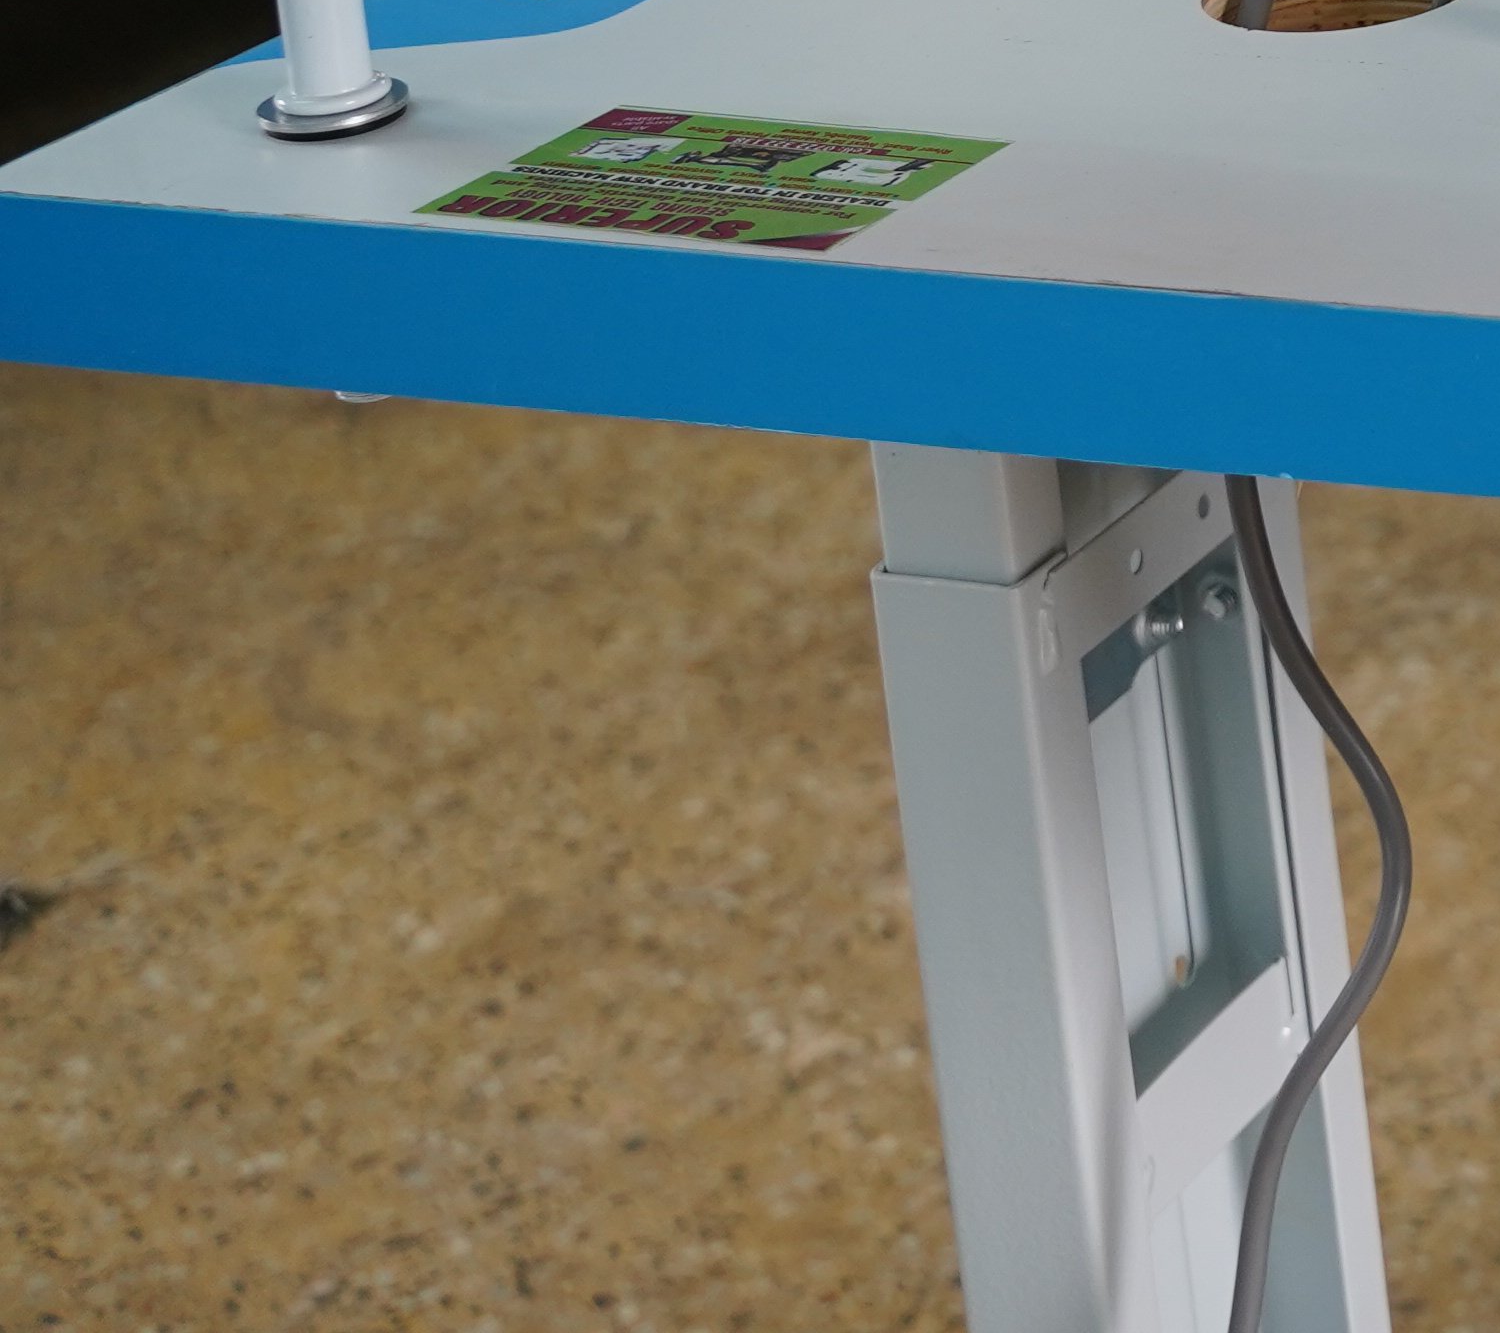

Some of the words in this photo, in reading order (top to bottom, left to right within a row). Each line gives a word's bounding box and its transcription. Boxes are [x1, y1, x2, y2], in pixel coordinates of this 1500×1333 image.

[512, 166, 612, 181] MACHINES
[611, 174, 661, 184] NEW
[529, 182, 592, 192] sewing
[662, 180, 733, 191] BRAND
[731, 187, 772, 195] TOP
[504, 189, 648, 209] TECH-NOLOGY
[595, 187, 676, 201] domestic
[772, 190, 799, 198] IN
[799, 193, 891, 207] DEALERS
[651, 202, 737, 216] SEWING
[713, 200, 818, 214] commercial
[437, 195, 756, 239] SUPERIOR
[822, 210, 857, 220] For
